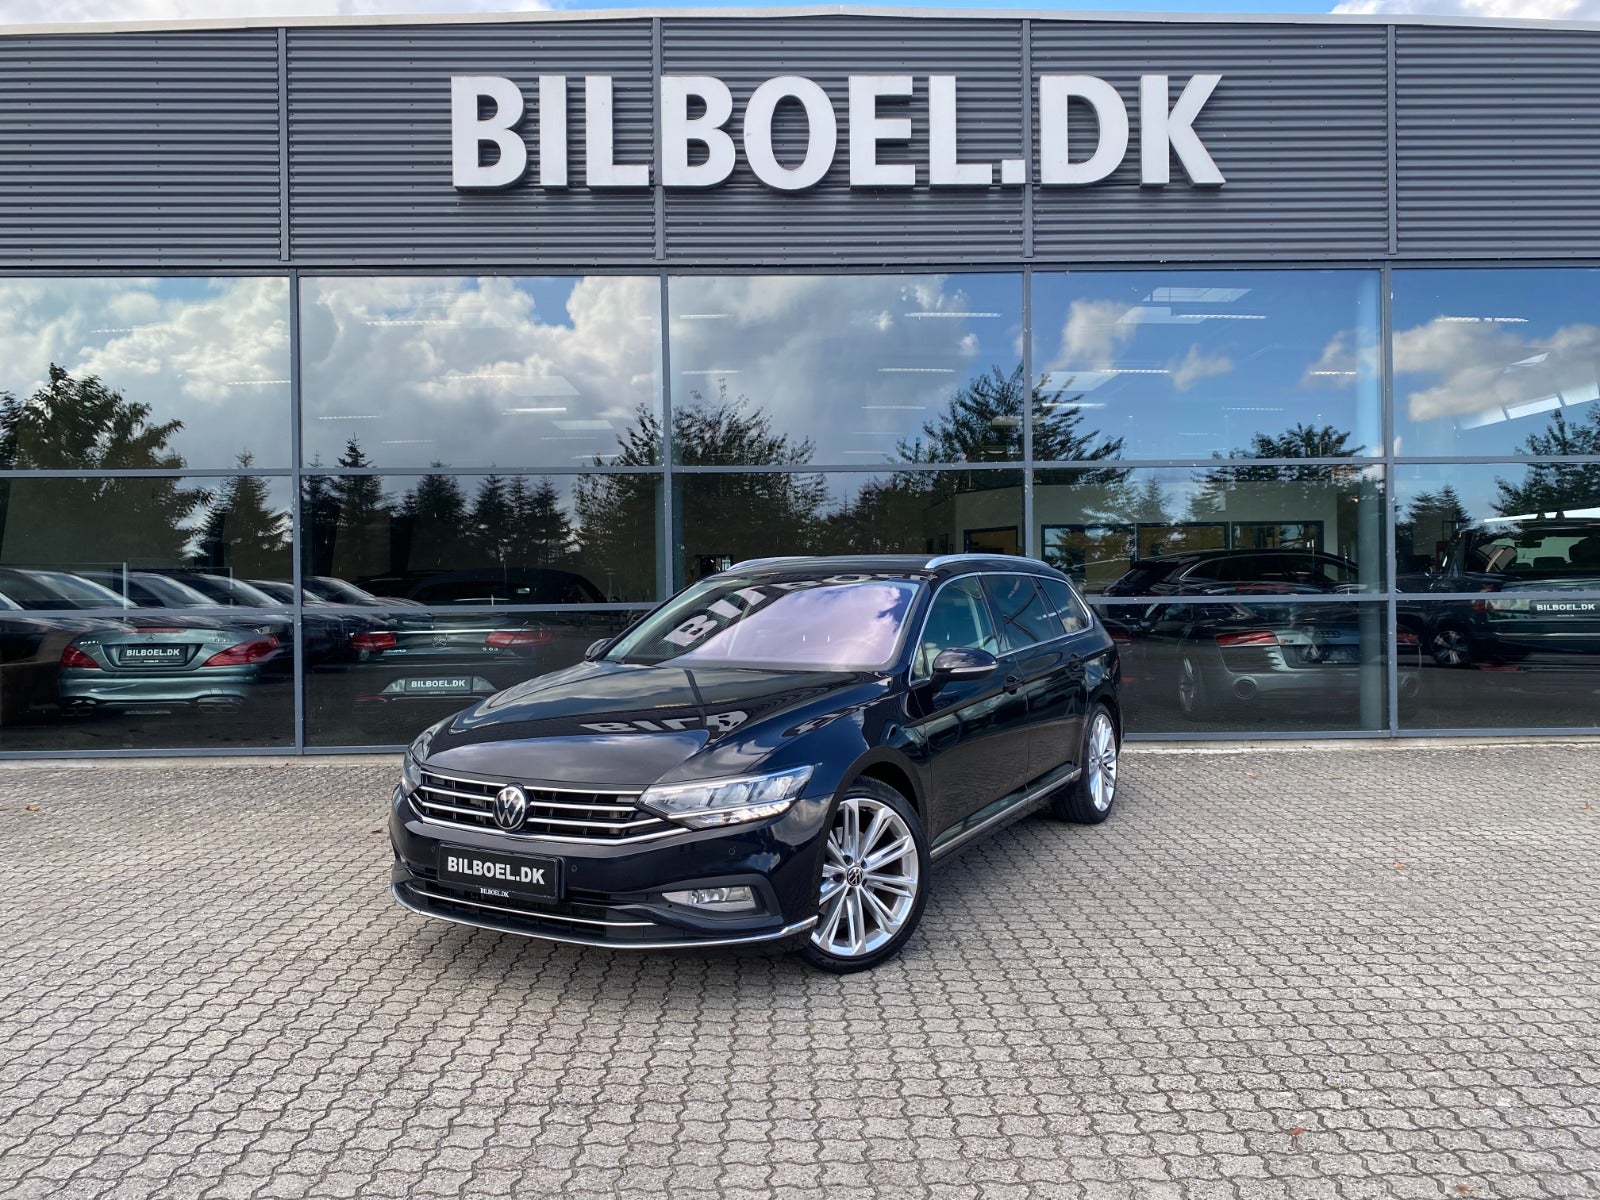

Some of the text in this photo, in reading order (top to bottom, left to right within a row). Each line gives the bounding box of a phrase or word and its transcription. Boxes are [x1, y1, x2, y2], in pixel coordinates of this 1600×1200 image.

[450, 74, 1227, 191] BILBOEL.DK
[1536, 603, 1596, 611] BILBOEL.DK
[126, 648, 181, 657] BILBOEL.DK
[411, 679, 466, 688] BILBOEL.DK
[447, 856, 546, 885] BILBOEL.DK
